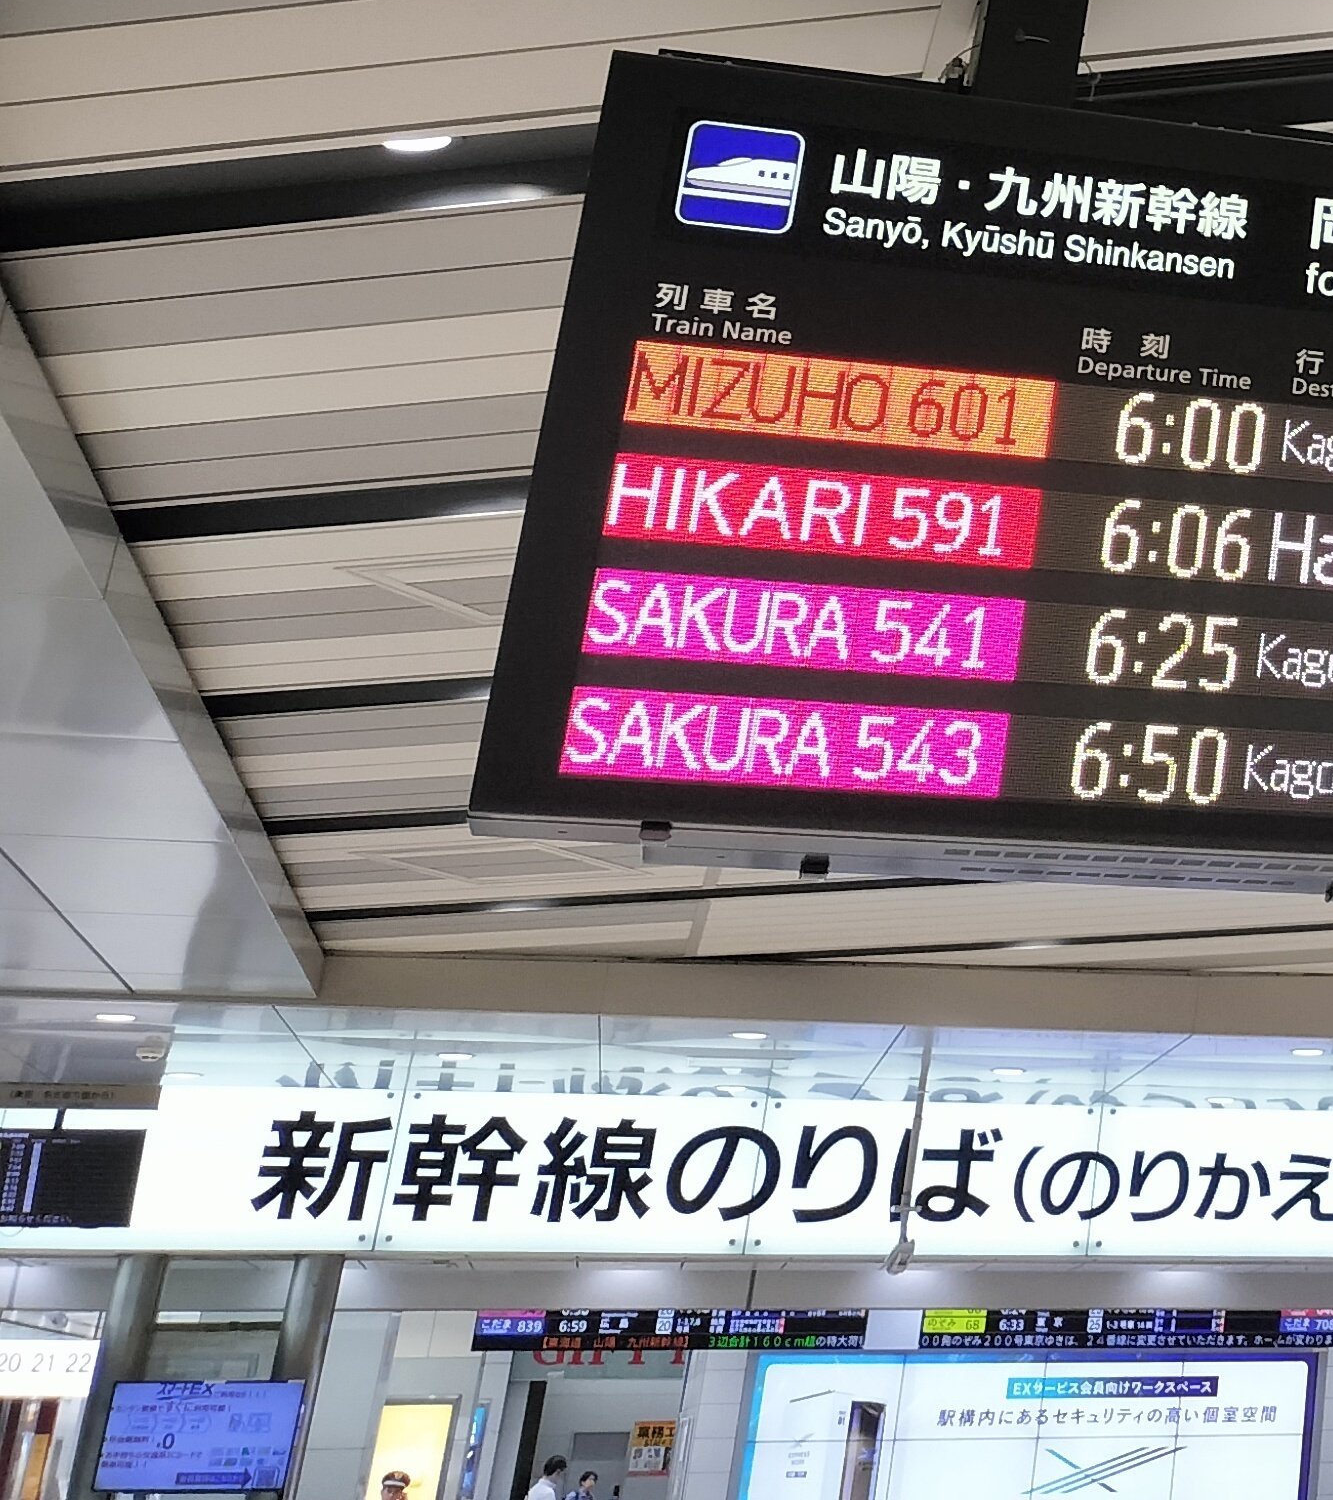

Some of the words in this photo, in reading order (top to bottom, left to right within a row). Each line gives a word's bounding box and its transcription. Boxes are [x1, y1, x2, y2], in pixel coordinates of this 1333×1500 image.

[830, 148, 1250, 242] 山陽・九州新幹線
[823, 207, 930, 250] Sanyō,
[941, 220, 1055, 262] Kyūshū
[1064, 234, 1235, 281] Shinkansen
[652, 313, 714, 340] Train
[722, 320, 792, 346] Name
[627, 349, 887, 434] MIZUHO
[907, 379, 1019, 446] 601
[1076, 356, 1192, 387] Departure
[1199, 368, 1252, 392] Time
[1116, 391, 1266, 475] 6:00
[606, 461, 872, 547] HIKARI
[891, 486, 1004, 558] 591
[1103, 498, 1252, 577] 6:06
[585, 577, 849, 662] SAKURA
[872, 599, 987, 673] 541
[1085, 608, 1239, 692] 6:25
[565, 695, 831, 780] SAKURA
[853, 716, 982, 790] 543
[1071, 721, 1229, 806] 6:50
[32, 1352, 54, 1372] 21
[65, 1352, 91, 1372] 22
[559, 1320, 588, 1333] 6:59
[999, 1319, 1025, 1331] 6:33
